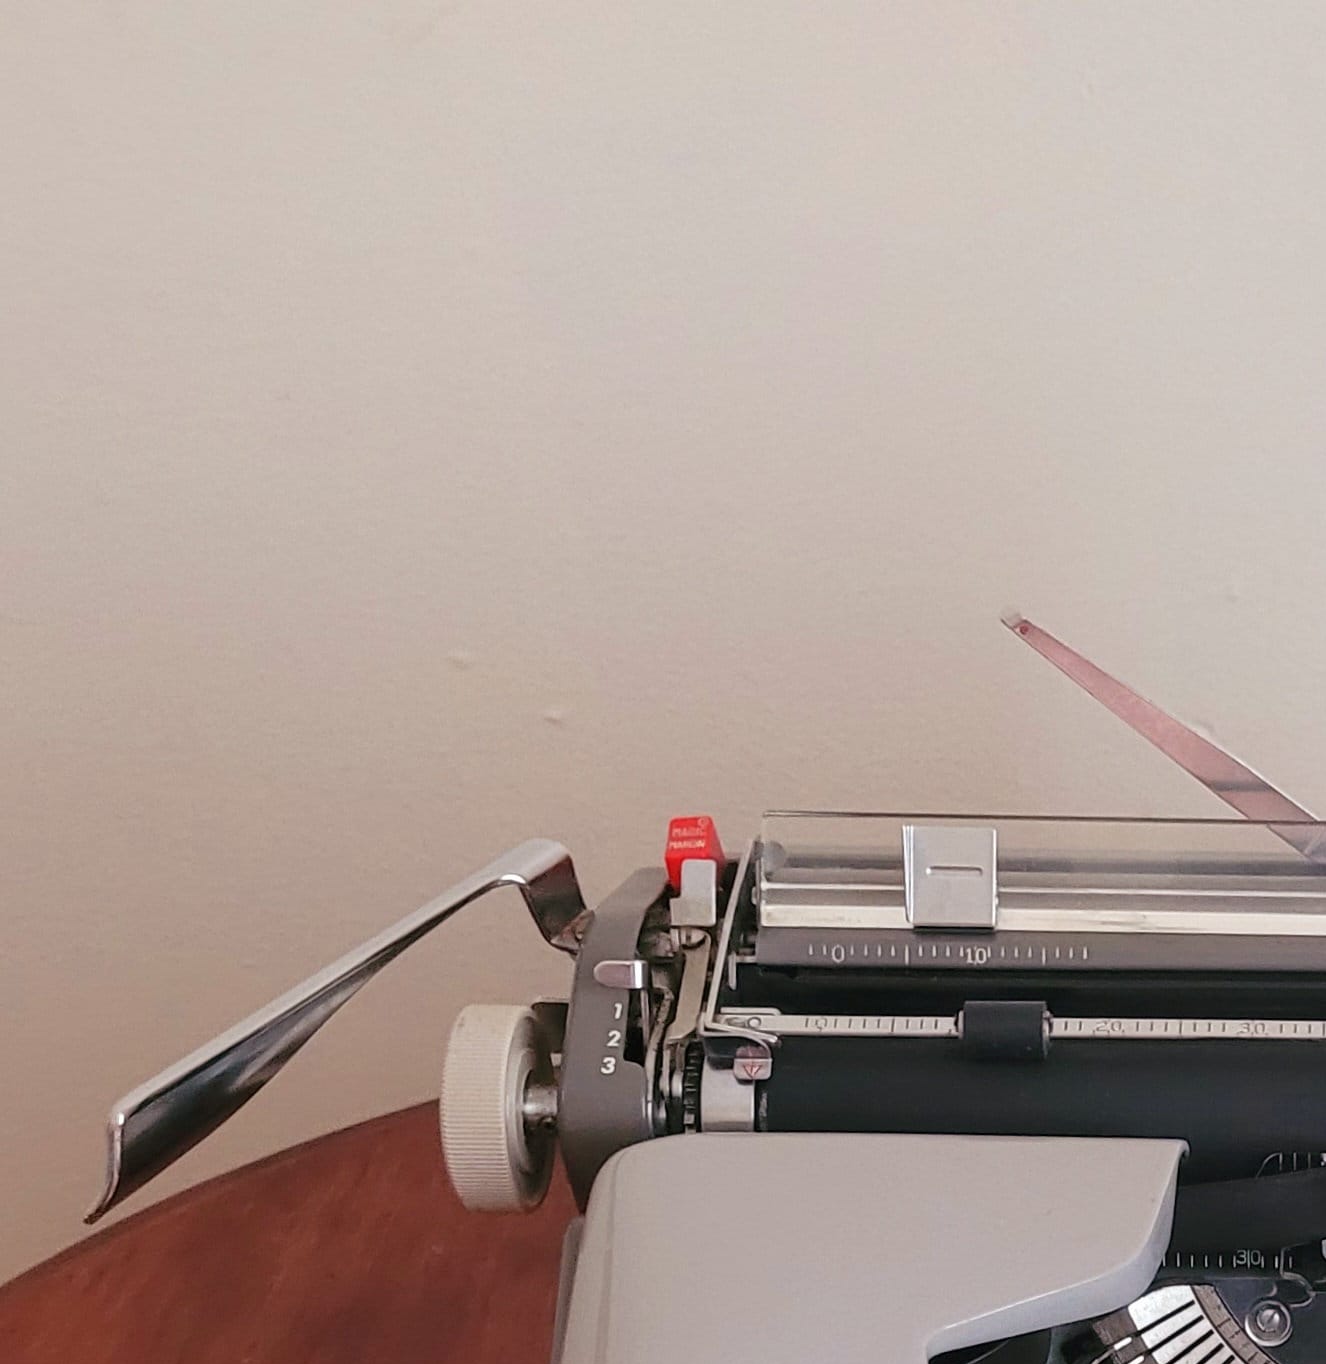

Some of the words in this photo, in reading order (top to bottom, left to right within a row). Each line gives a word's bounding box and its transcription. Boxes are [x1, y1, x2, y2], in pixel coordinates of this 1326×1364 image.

[831, 944, 846, 963] 0
[966, 947, 987, 964] 10
[614, 1003, 623, 1020] 1
[606, 1029, 621, 1047] 2
[600, 1056, 616, 1074] 3
[1236, 1249, 1261, 1265] 30
